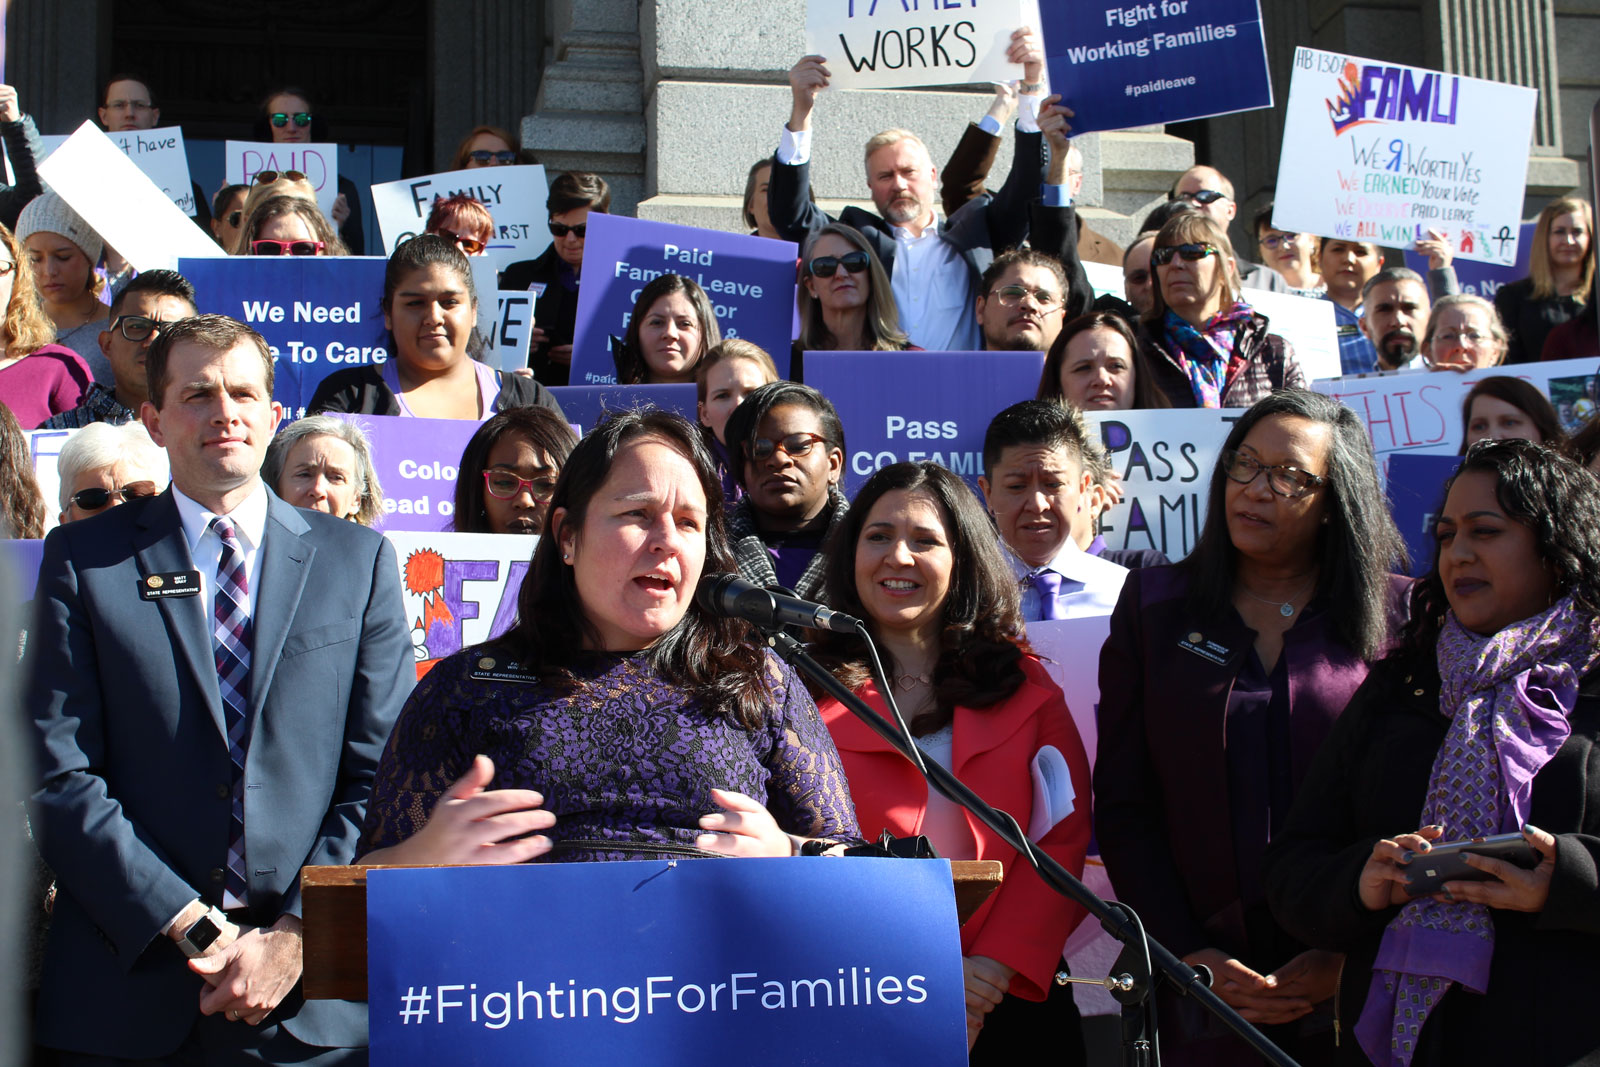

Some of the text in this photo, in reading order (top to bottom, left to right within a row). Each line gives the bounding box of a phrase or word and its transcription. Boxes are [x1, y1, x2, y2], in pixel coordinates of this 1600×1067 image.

[1106, 0, 1188, 27] Fight for
[839, 21, 976, 73] WORKS
[1068, 24, 1237, 65] Working Families
[1125, 75, 1196, 97] #paidleave
[1361, 65, 1459, 125] FAMLI
[137, 135, 176, 153] have
[1364, 173, 1420, 195] EARNED
[1411, 203, 1439, 218] PAID
[1356, 221, 1376, 237] ALL
[664, 244, 713, 266] Paid
[697, 273, 763, 298] Leave
[242, 301, 361, 323] We Need
[711, 299, 738, 319] or
[287, 341, 318, 363] To
[325, 341, 388, 364] Care
[886, 415, 958, 439] Pass
[1100, 421, 1199, 482] PASS
[398, 459, 459, 481] Colo
[852, 451, 897, 476] CO
[386, 496, 429, 516] ead
[399, 966, 928, 1031] #FightingForFamilies
